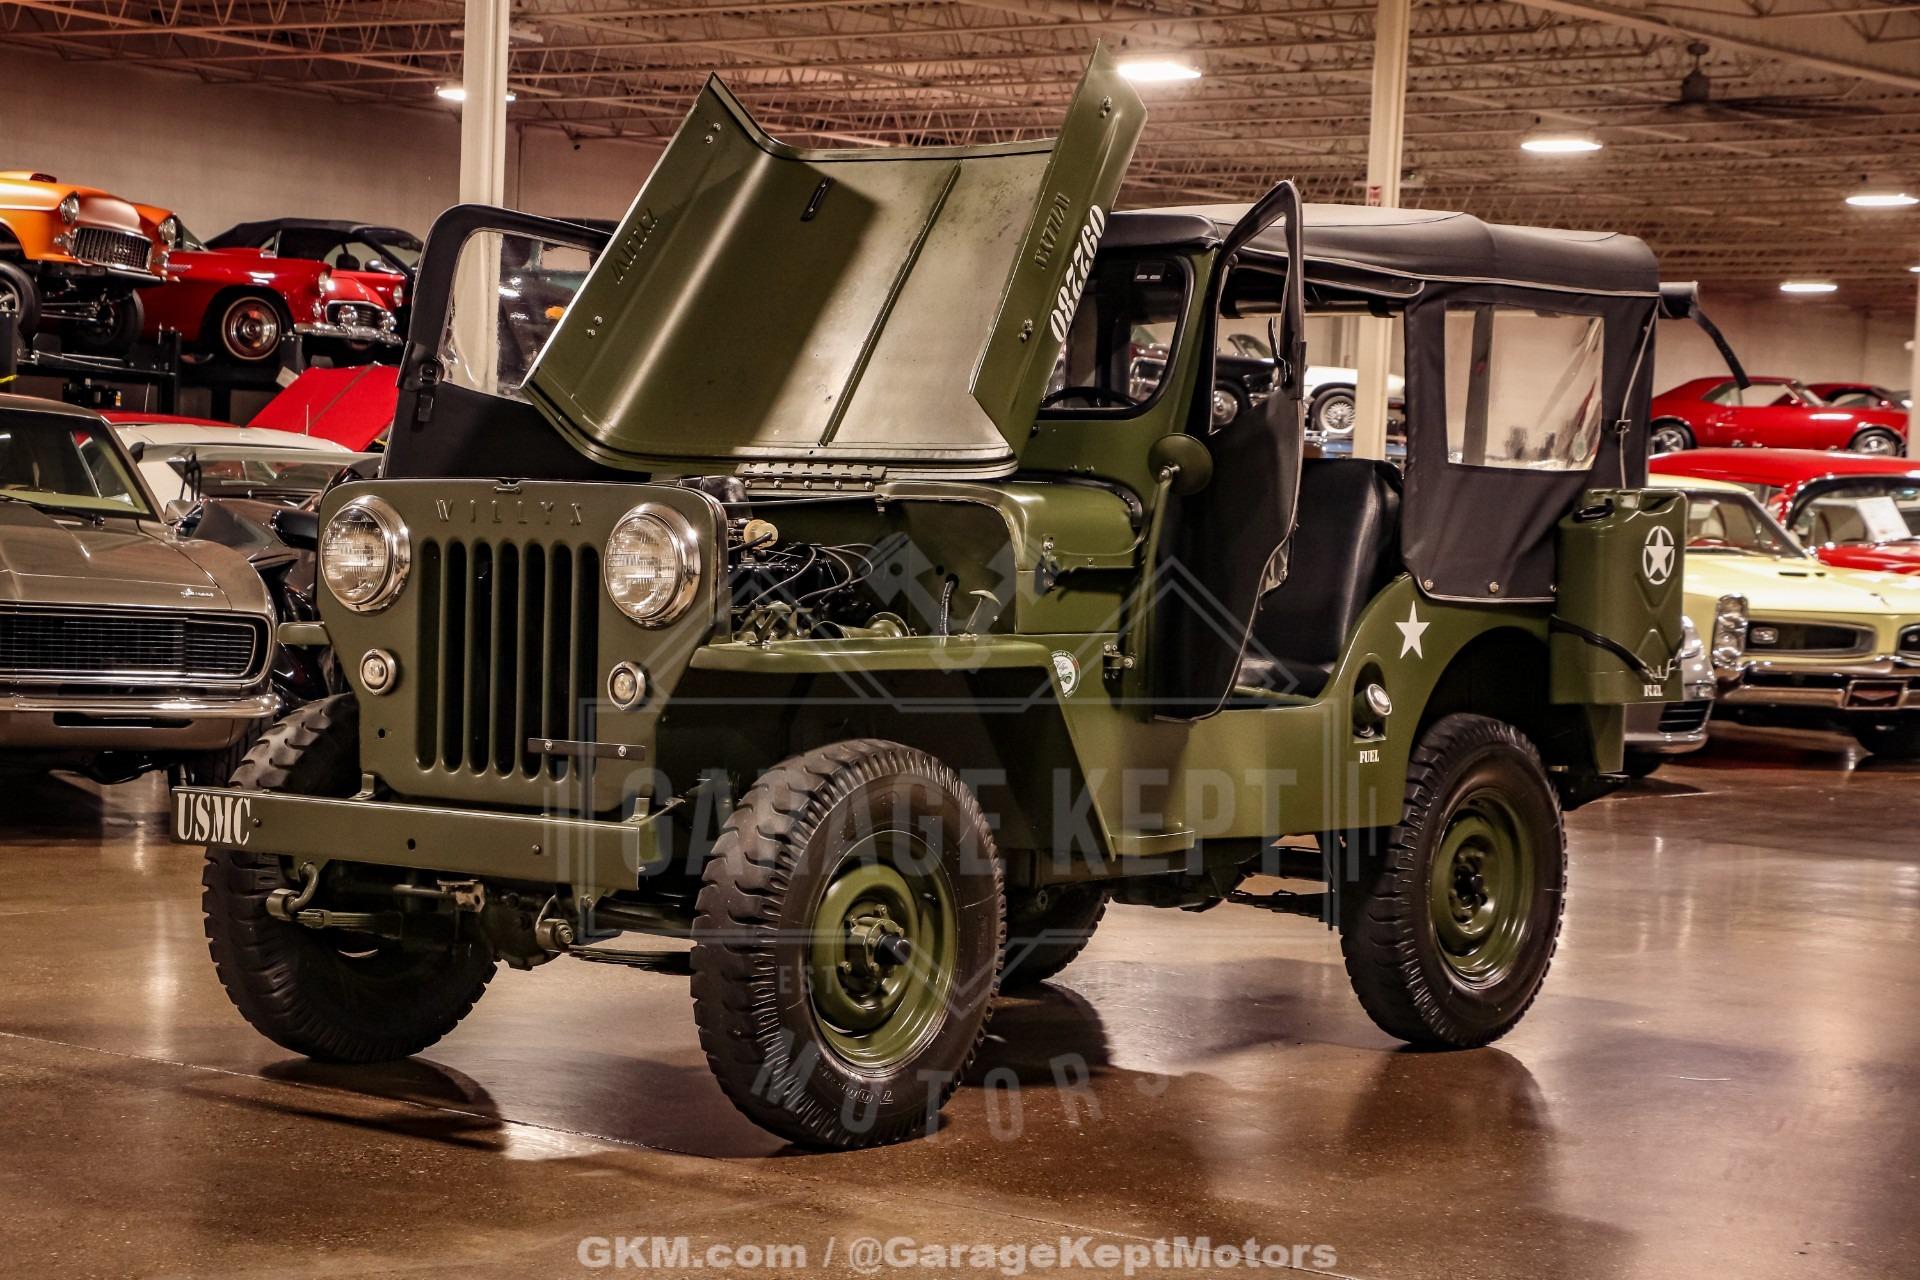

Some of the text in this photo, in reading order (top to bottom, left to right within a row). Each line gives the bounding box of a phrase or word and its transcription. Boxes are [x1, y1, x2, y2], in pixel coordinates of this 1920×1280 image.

[436, 499, 581, 526] WILLYS
[1359, 749, 1380, 764] FUEL
[177, 792, 251, 846] USMC
